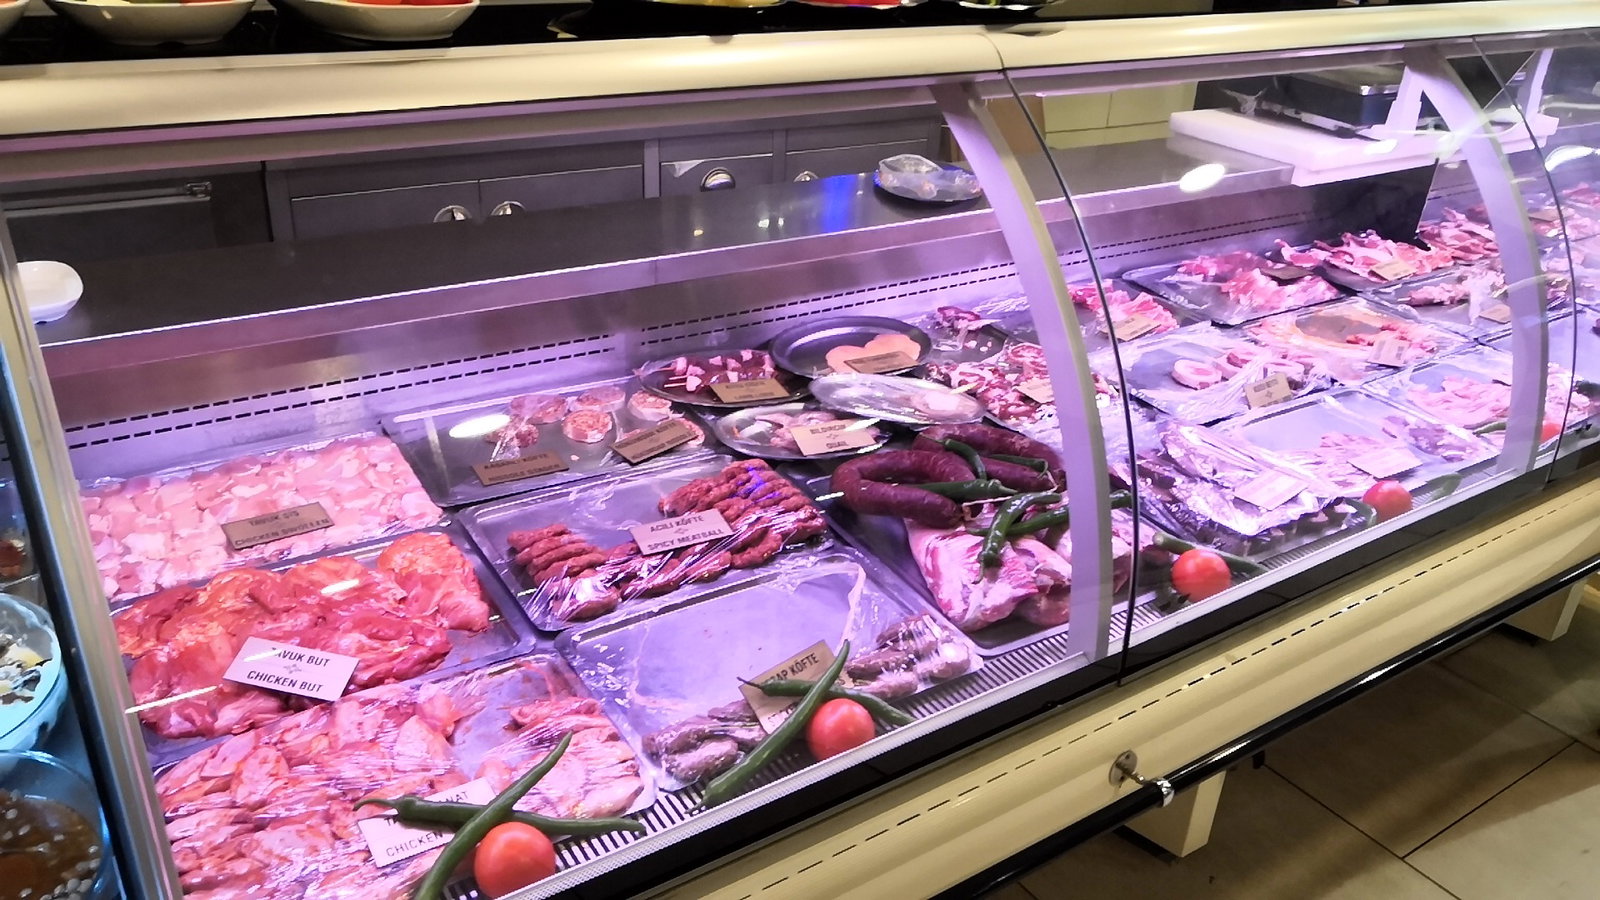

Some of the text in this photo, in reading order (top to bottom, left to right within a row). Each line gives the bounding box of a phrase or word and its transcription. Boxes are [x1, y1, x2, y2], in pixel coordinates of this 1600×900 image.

[235, 532, 279, 546] CHICKEN
[647, 529, 724, 551] SPICY MEATBALL
[306, 655, 331, 667] BUT
[788, 652, 819, 676] KÖFTE
[246, 670, 325, 693] CHICKEN BUT
[385, 832, 445, 857] CHICKEN
